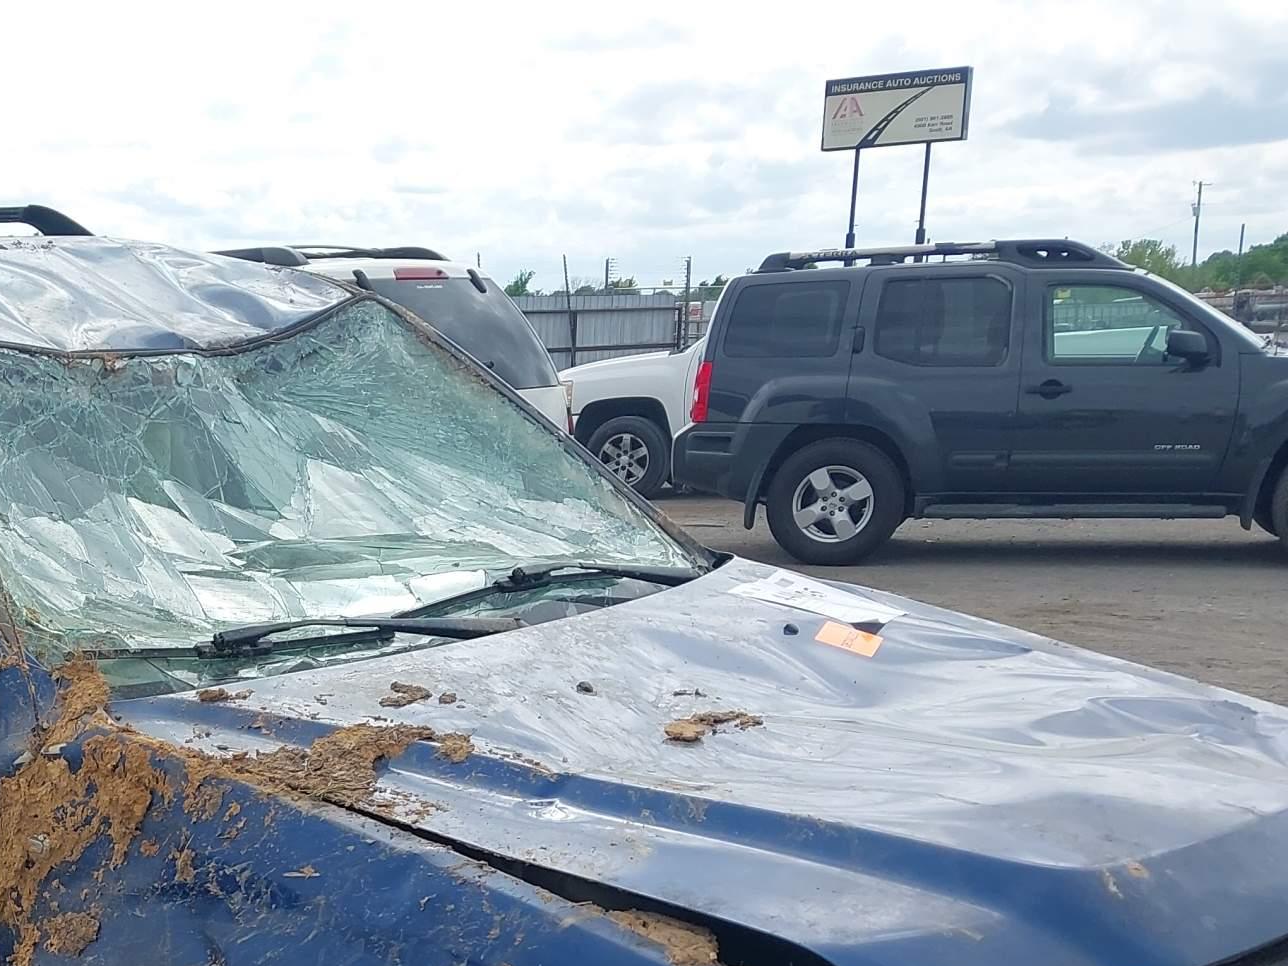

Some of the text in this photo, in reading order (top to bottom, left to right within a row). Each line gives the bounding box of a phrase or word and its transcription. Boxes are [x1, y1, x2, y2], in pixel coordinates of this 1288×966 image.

[832, 73, 961, 92] INSURANCE AUTO AUCTIONS
